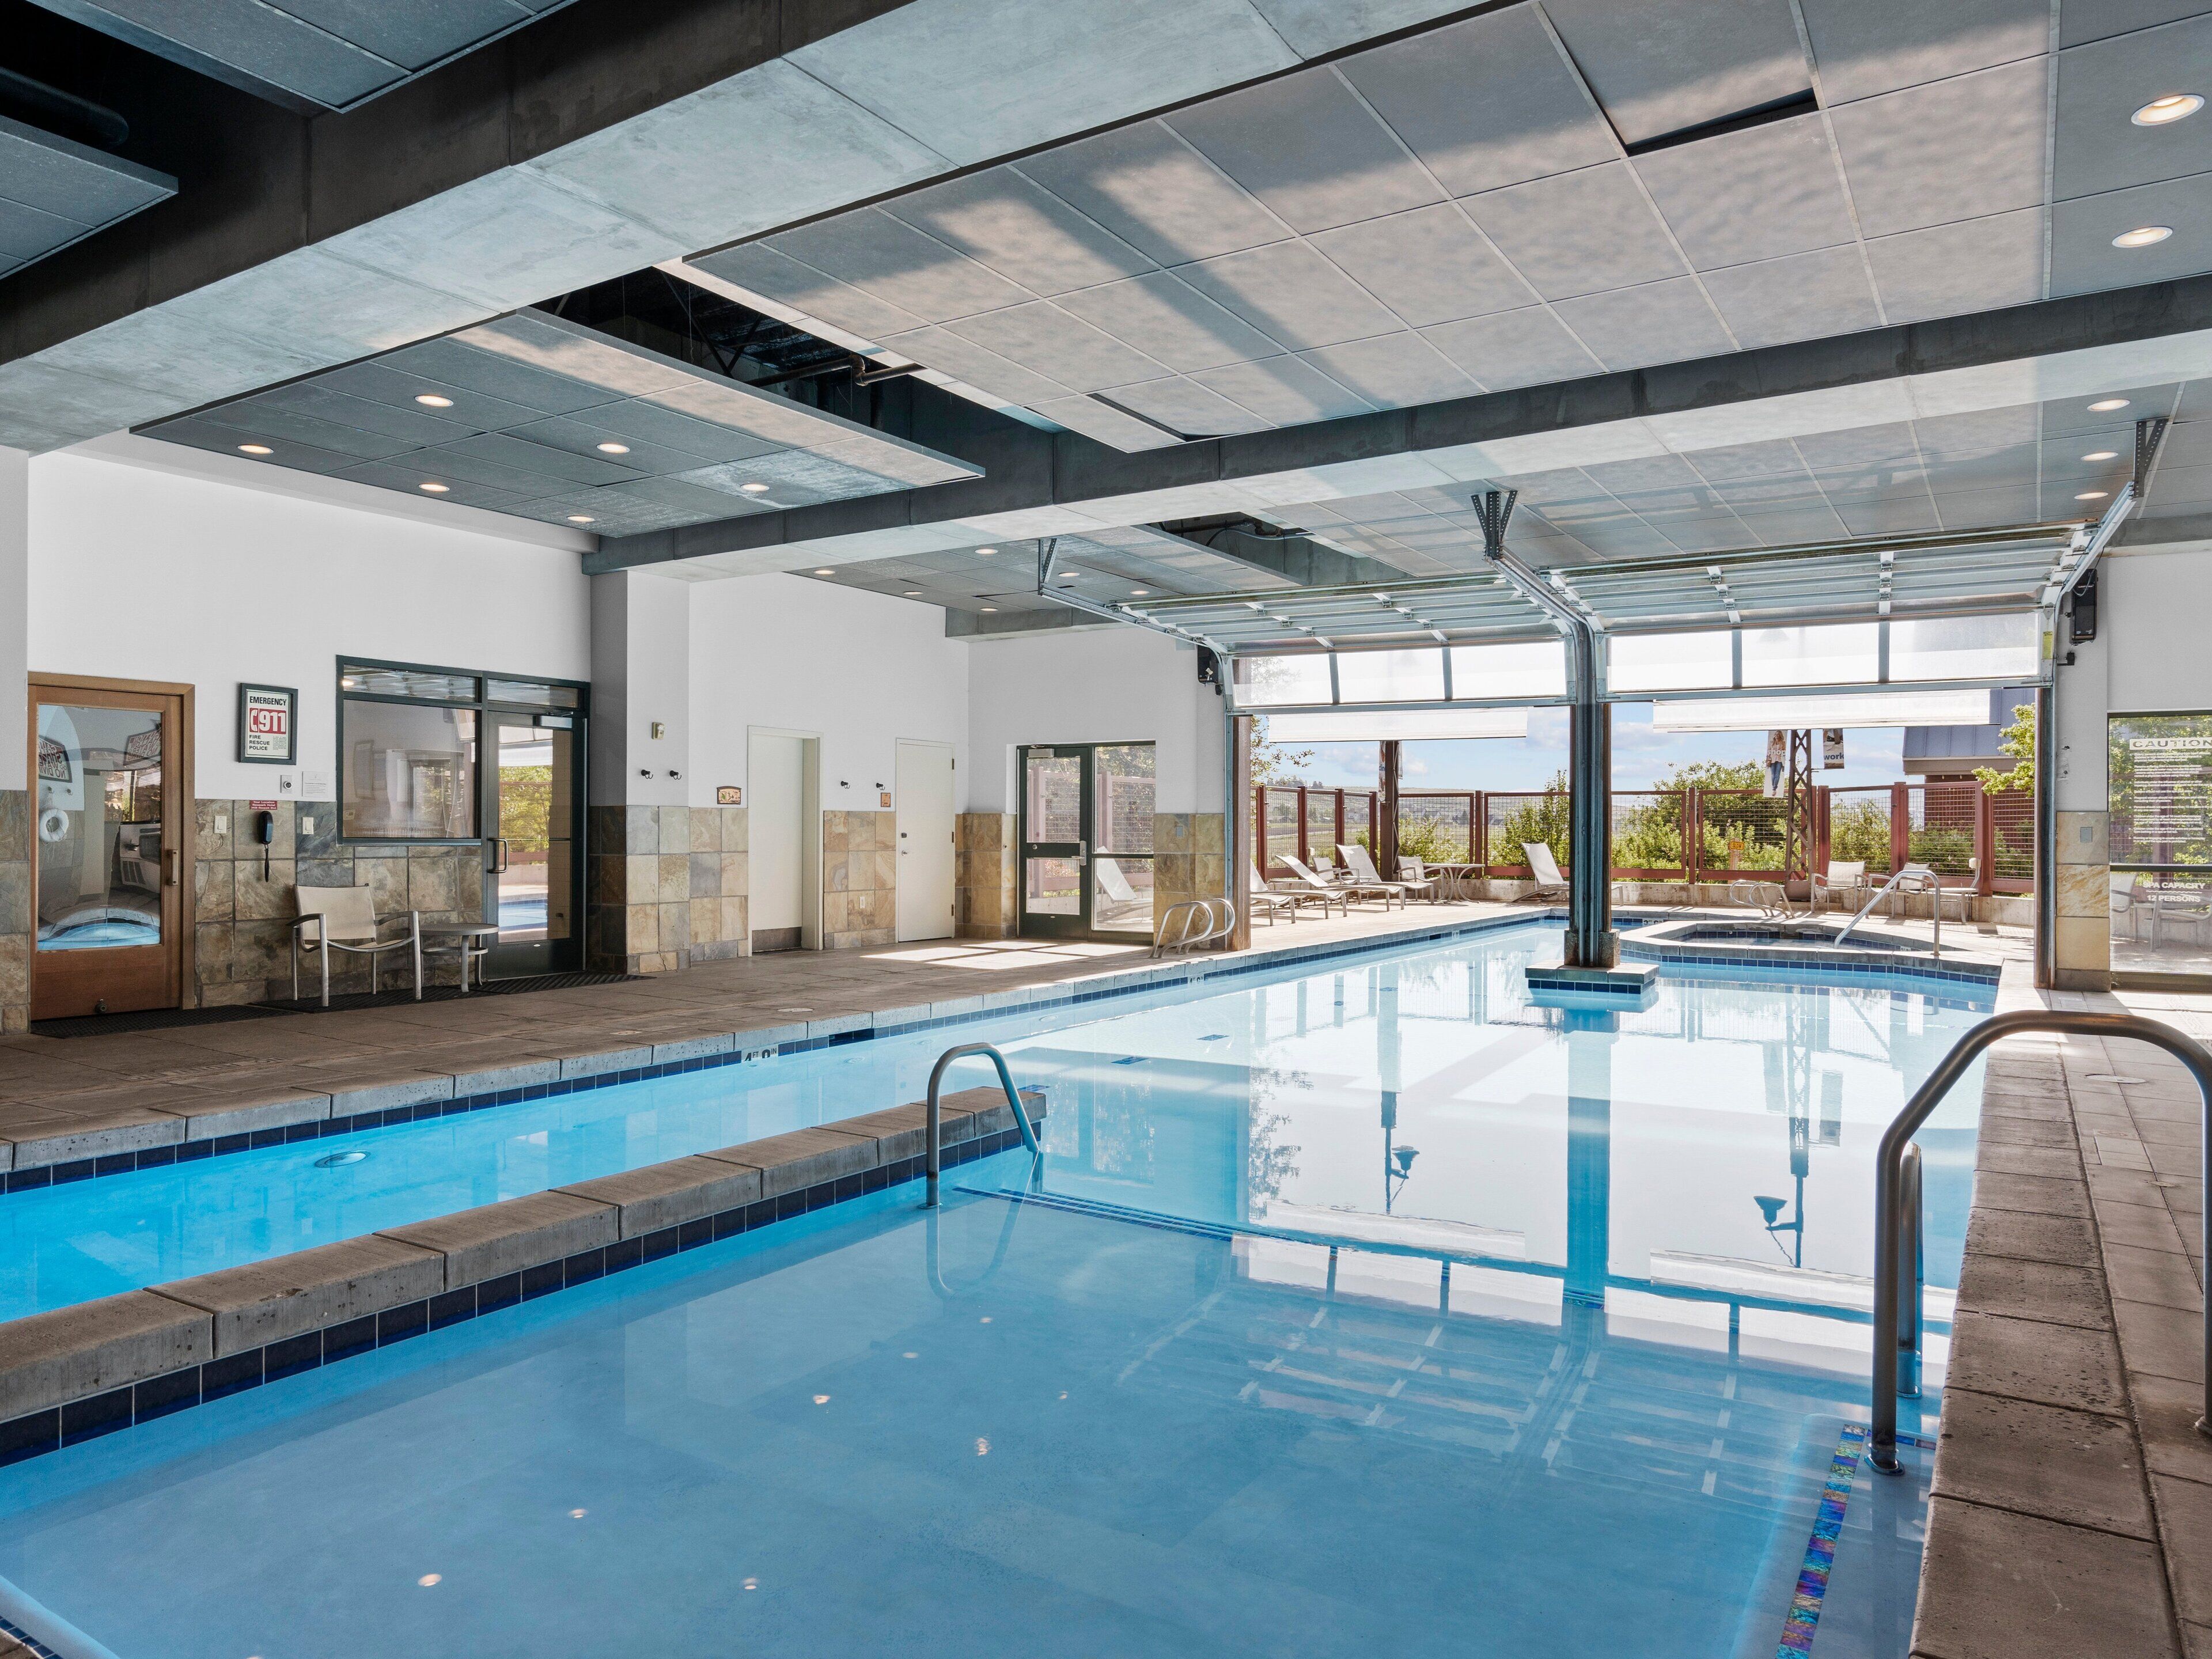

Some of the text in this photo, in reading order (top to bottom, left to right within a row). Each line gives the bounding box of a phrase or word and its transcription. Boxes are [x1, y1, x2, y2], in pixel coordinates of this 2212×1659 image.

[249, 696, 286, 706] EMERGENCY
[259, 710, 286, 732] 911
[2133, 740, 2212, 748] CAUTION
[1824, 752, 1844, 760] work
